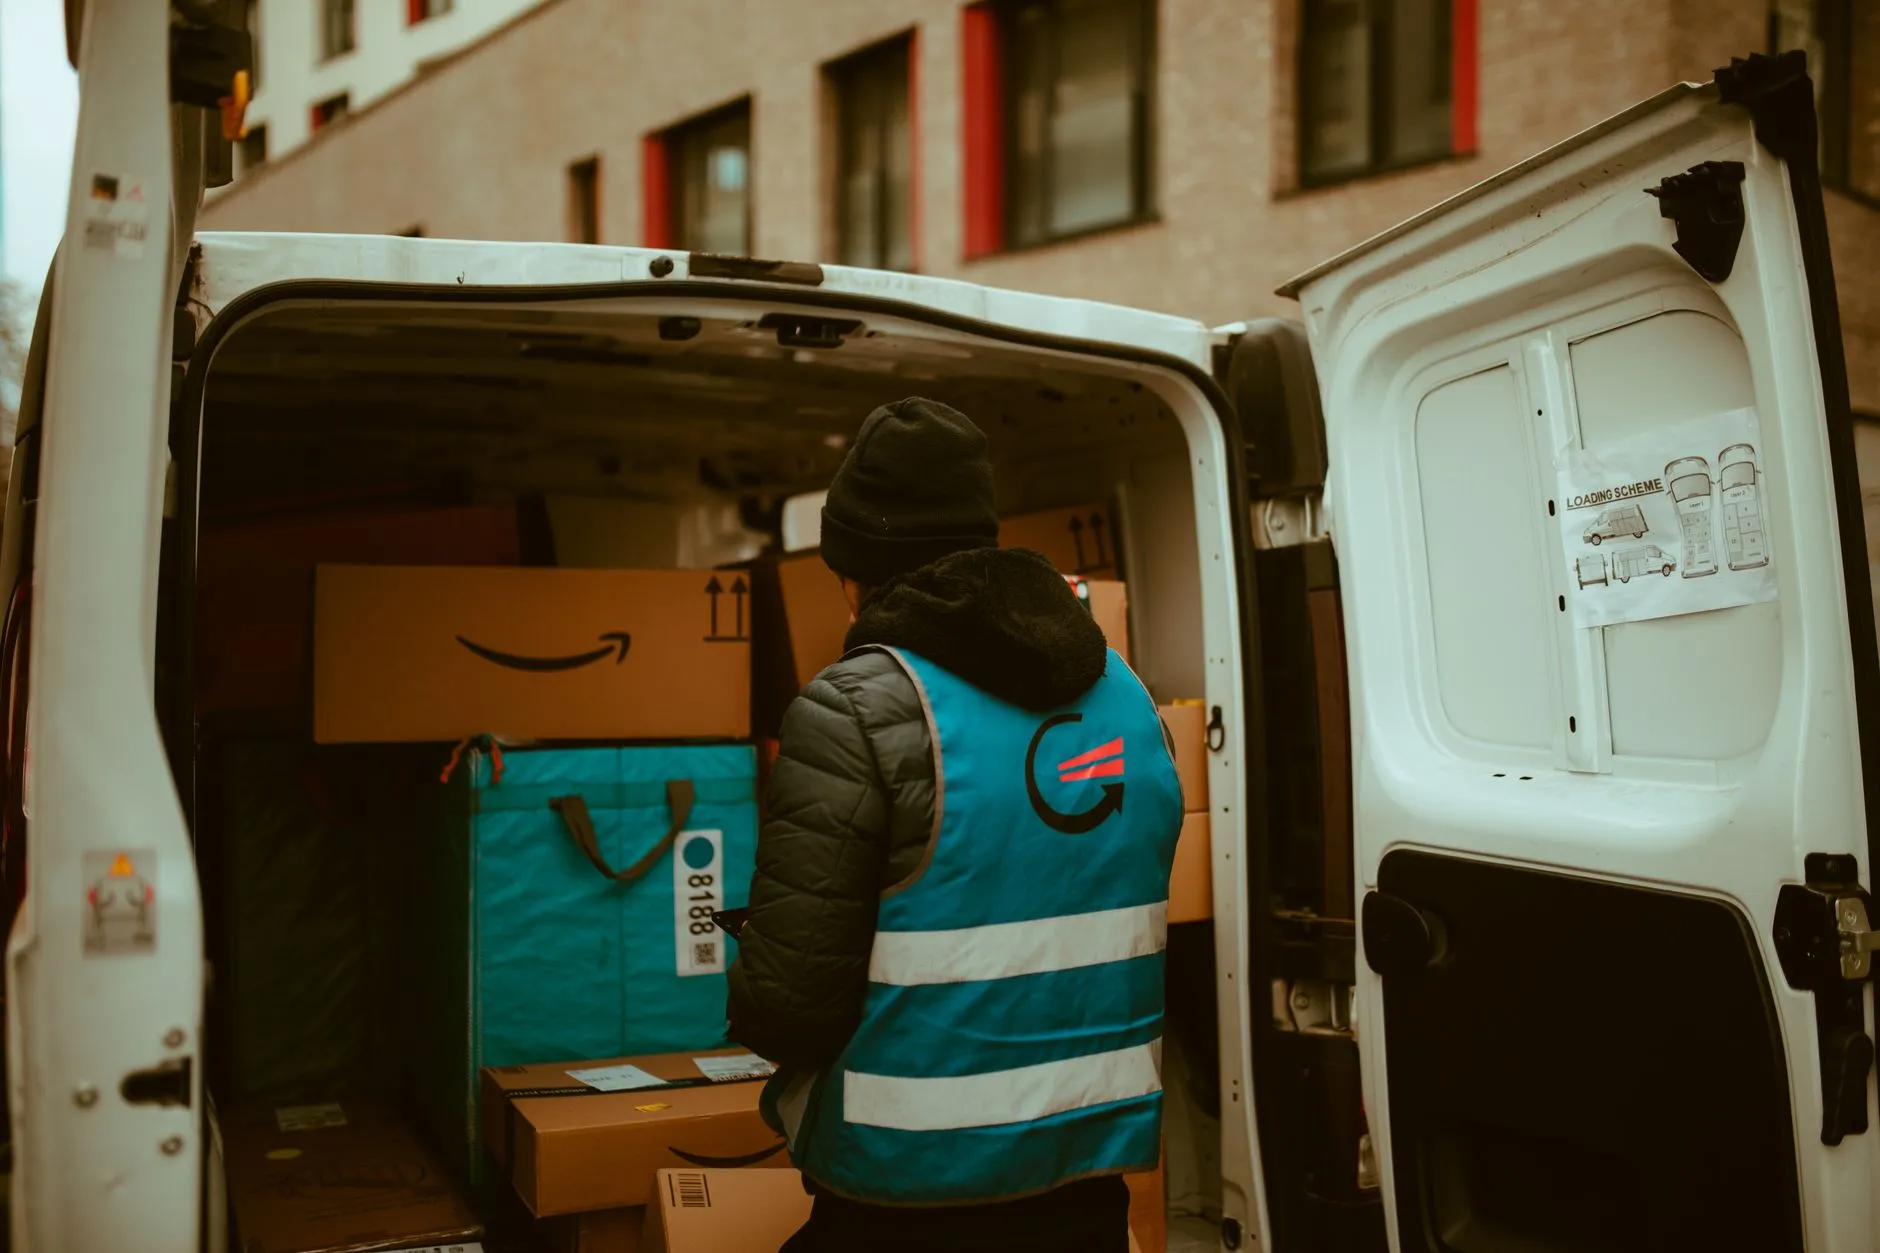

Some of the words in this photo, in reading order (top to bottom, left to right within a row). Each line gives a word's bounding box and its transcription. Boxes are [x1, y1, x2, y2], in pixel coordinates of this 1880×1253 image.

[1567, 489, 1613, 507] LOADING
[1614, 478, 1663, 498] SCHEME
[688, 874, 715, 936] 8188
